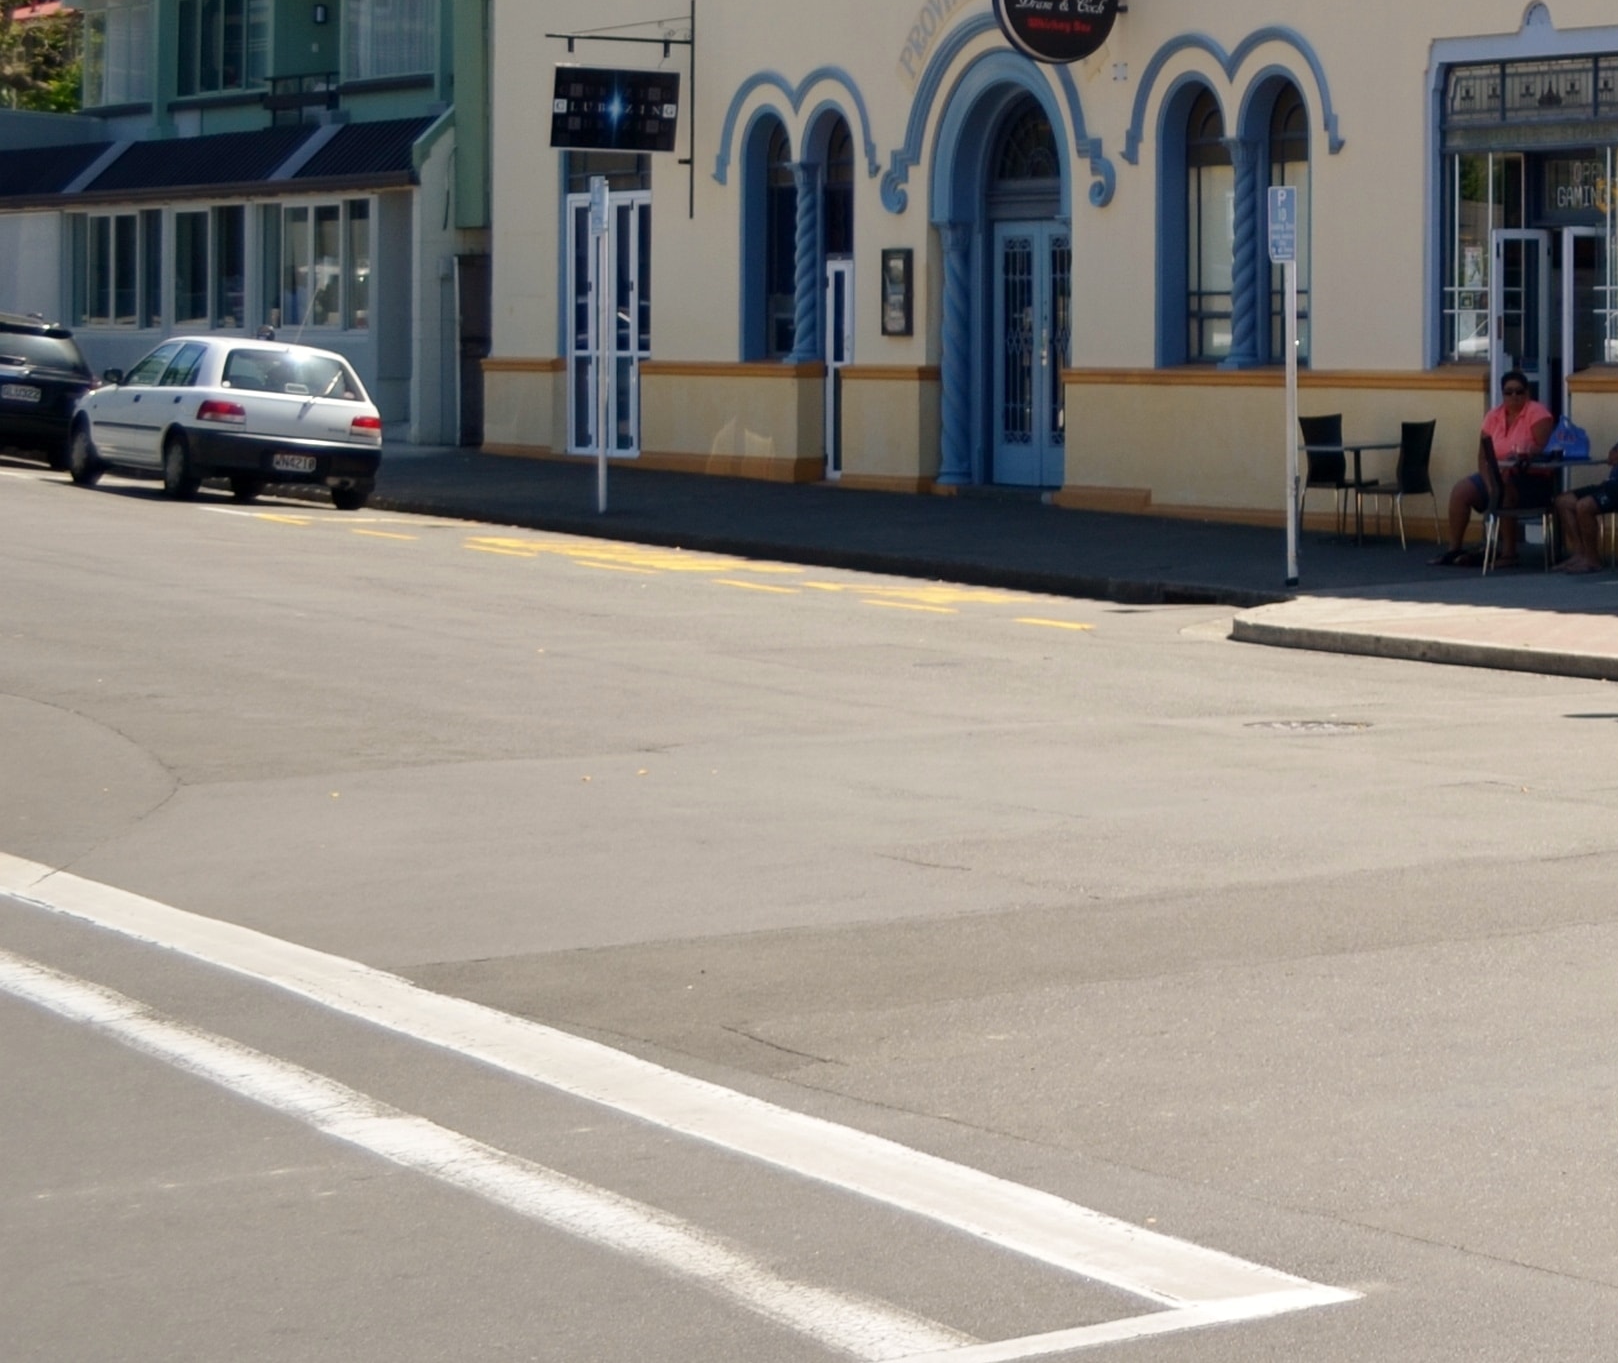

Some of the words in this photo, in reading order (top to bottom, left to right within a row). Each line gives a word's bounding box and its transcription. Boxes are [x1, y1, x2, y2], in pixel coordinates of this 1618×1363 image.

[554, 99, 606, 113] CLUB
[624, 104, 676, 118] ZING
[1278, 190, 1287, 206] P
